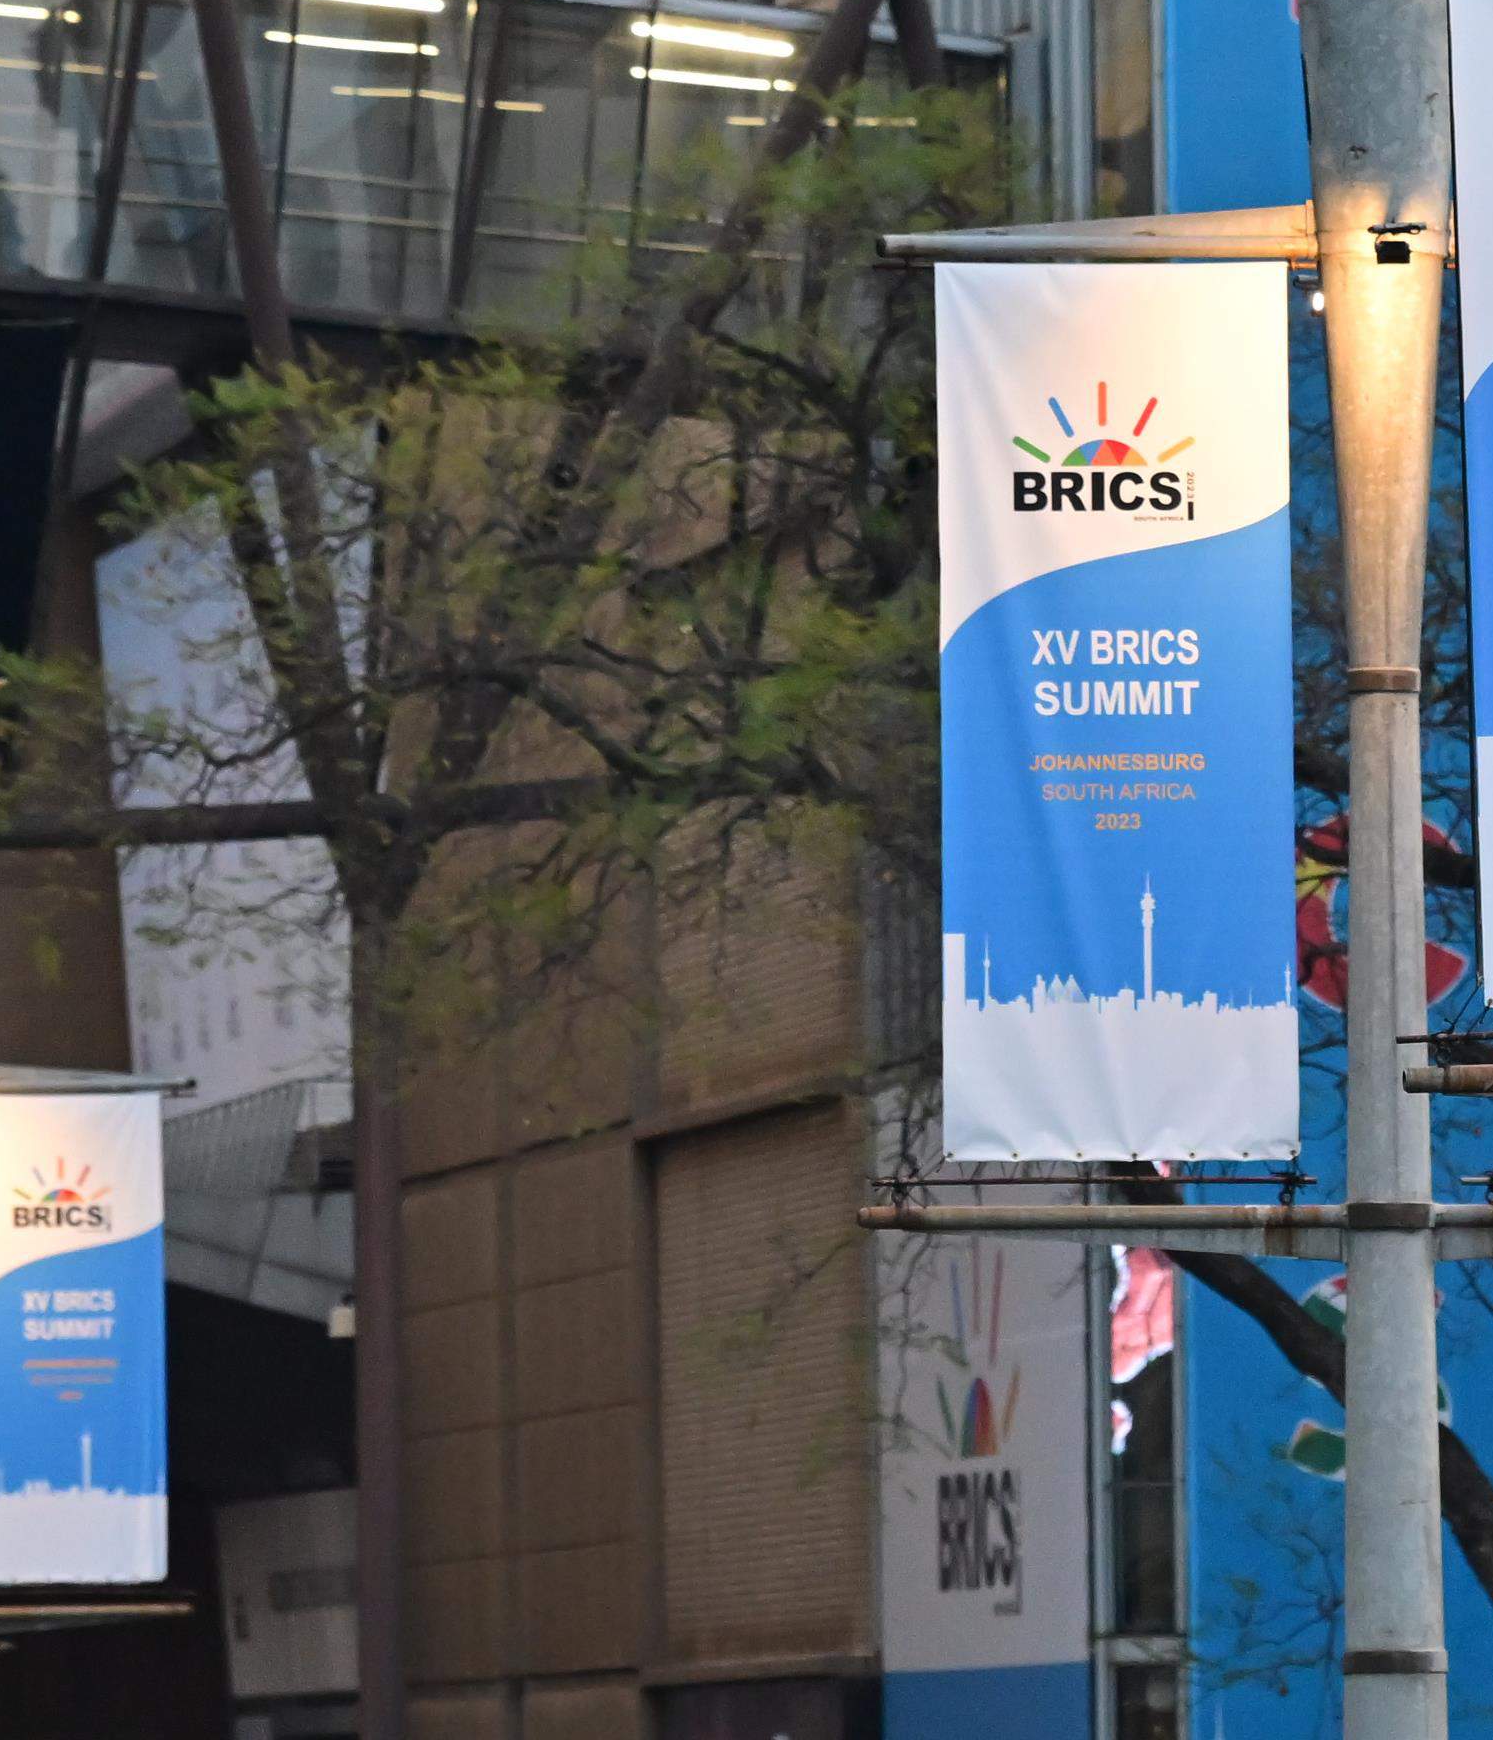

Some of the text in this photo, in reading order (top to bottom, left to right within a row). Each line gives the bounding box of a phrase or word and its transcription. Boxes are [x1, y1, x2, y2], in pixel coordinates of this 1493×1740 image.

[1013, 471, 1182, 512] BRICS
[1032, 628, 1200, 665] XV BRICS
[1034, 680, 1200, 716] SUMMIT
[1030, 752, 1206, 772] JOHANNESBURG
[1042, 782, 1196, 801] SOUTH AFRICA
[1094, 812, 1141, 831] 2023
[12, 1204, 105, 1228] BRICS
[938, 1469, 1017, 1592] BRICS
